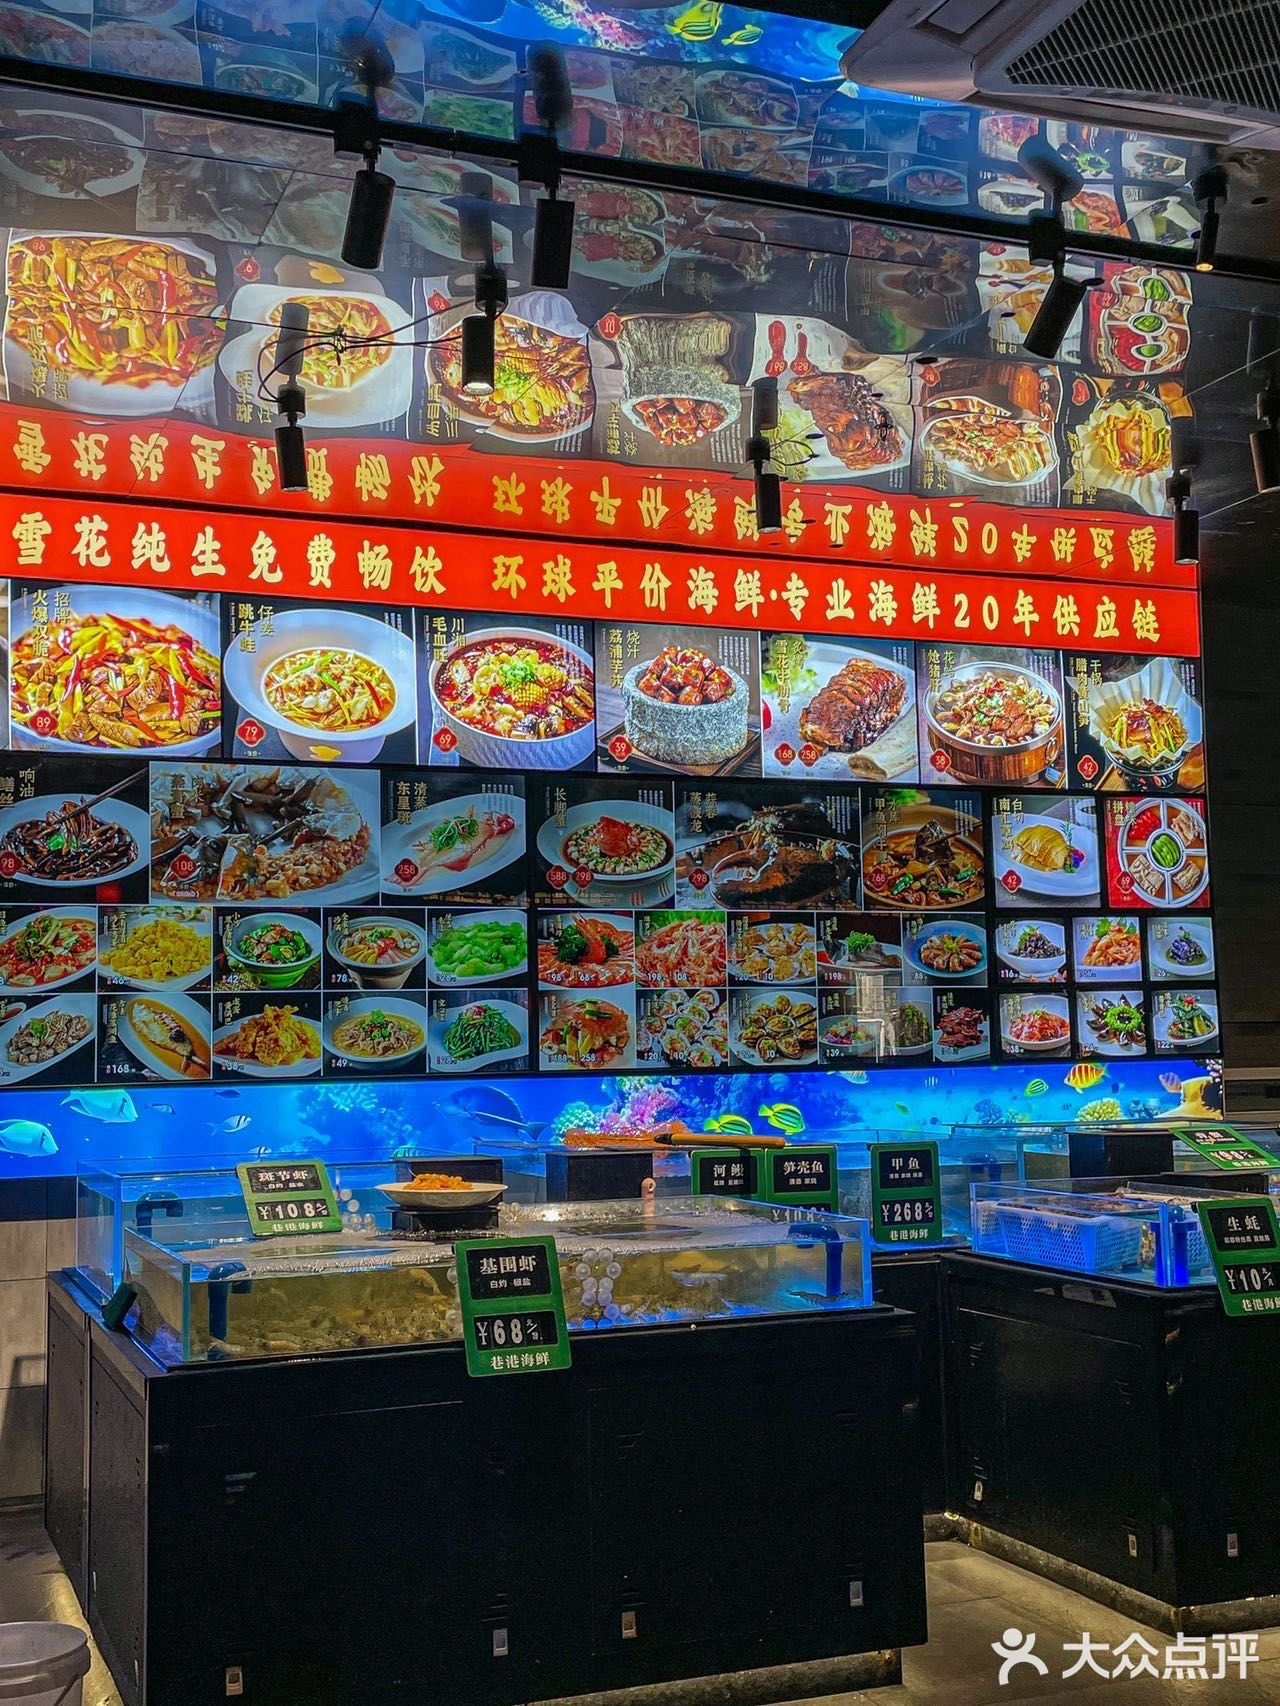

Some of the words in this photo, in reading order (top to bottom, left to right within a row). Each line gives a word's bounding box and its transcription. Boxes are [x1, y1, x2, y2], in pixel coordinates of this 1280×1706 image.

[12, 511, 447, 594] 雪花纯生免费畅饮
[54, 591, 71, 623] 招牌
[32, 589, 49, 657] 火爆双脆
[238, 603, 256, 653] 跳牛蛙
[432, 616, 448, 663] 毛血旺
[36, 716, 51, 728] 89
[245, 726, 258, 736] 79
[439, 734, 452, 745] 69
[614, 742, 626, 752] 39
[777, 748, 794, 760] 168
[800, 750, 816, 761] 258
[19, 767, 35, 798] 响油
[397, 781, 411, 825] 东星斑
[1, 857, 15, 868] 98
[174, 859, 194, 871] 108
[399, 864, 416, 874] 258
[550, 871, 567, 881] 588
[575, 871, 592, 882] 298
[692, 873, 707, 883] 298
[783, 1160, 824, 1175] 笋壳鱼
[1227, 1215, 1261, 1232] 生蚝
[490, 1352, 550, 1370] 巷港海鲜
